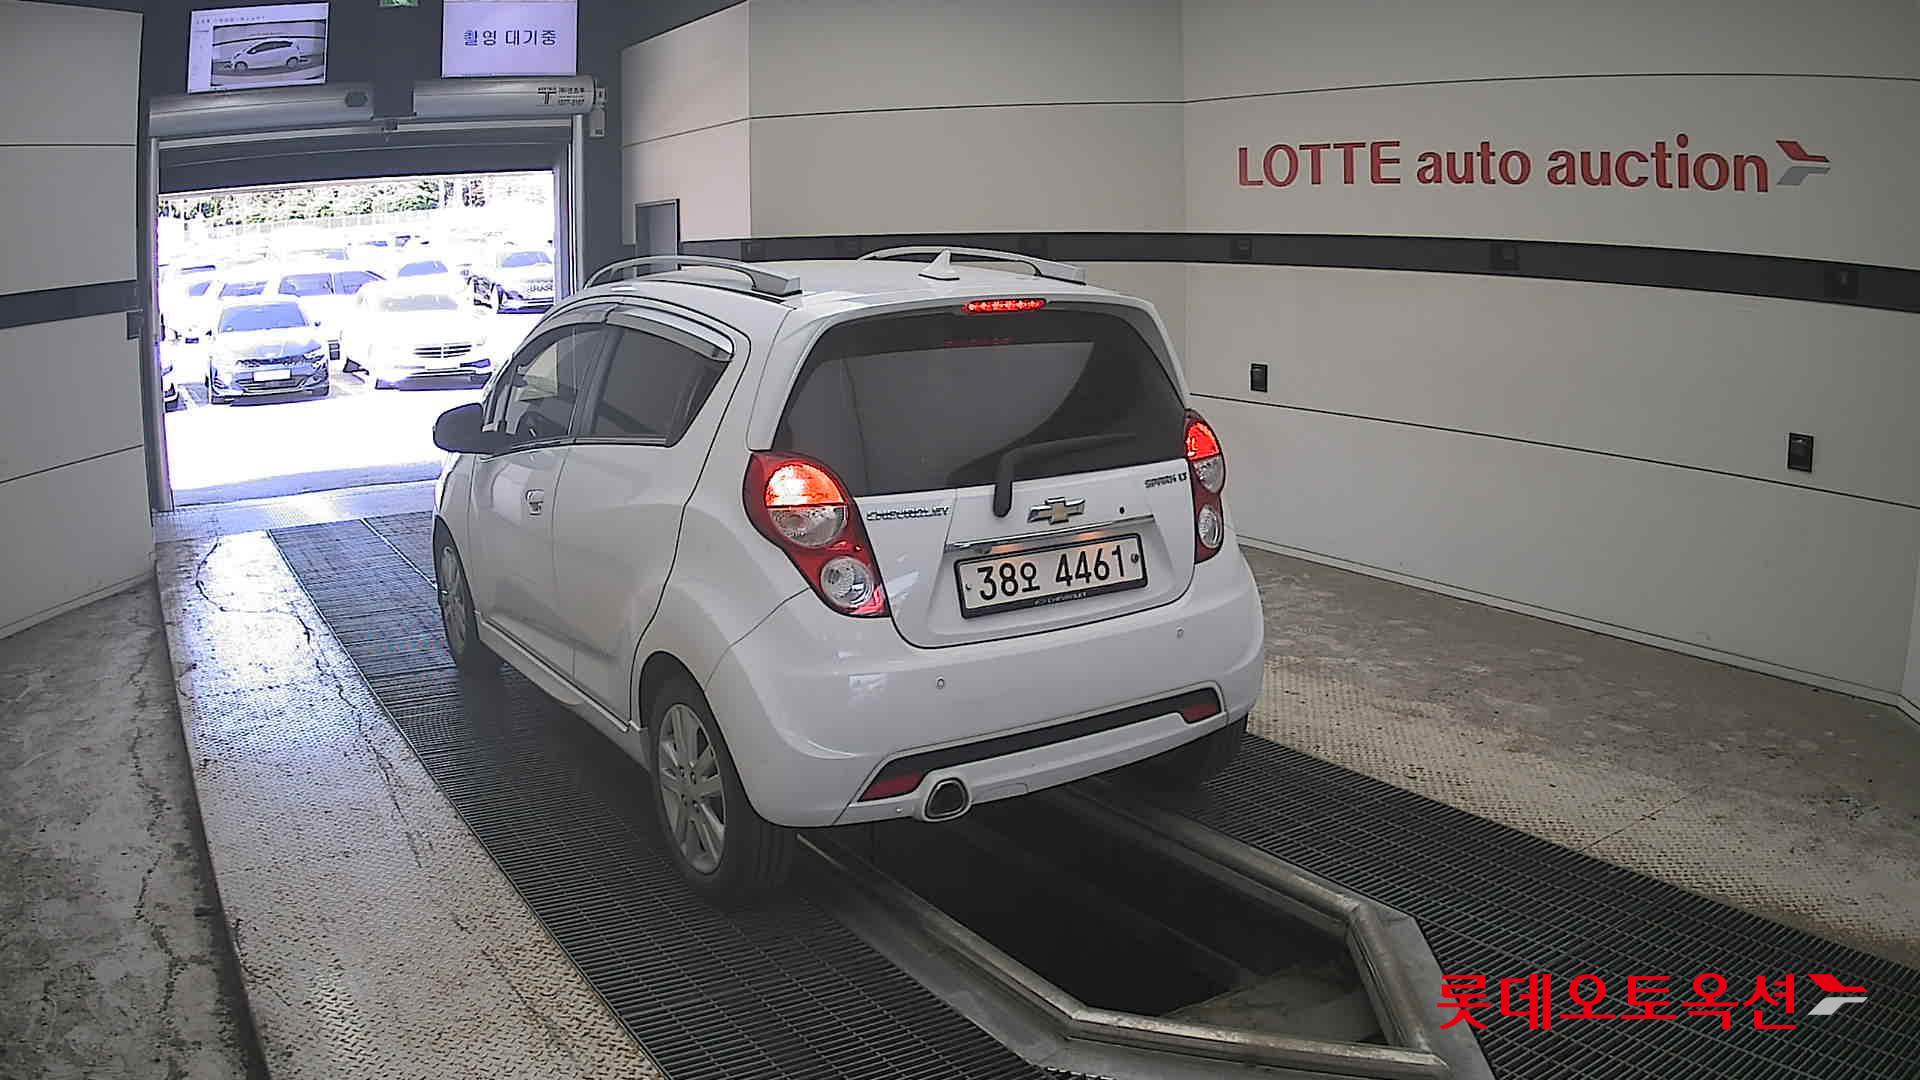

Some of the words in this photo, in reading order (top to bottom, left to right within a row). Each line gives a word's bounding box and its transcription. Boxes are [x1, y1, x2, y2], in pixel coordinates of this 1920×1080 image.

[463, 29, 497, 46] 촬영
[505, 29, 557, 46] 대기중
[1238, 141, 1401, 187] LOTTE
[1416, 141, 1531, 185] auto
[1547, 134, 1769, 192] auction
[976, 561, 1041, 601] 38오
[1055, 544, 1126, 587] 4461
